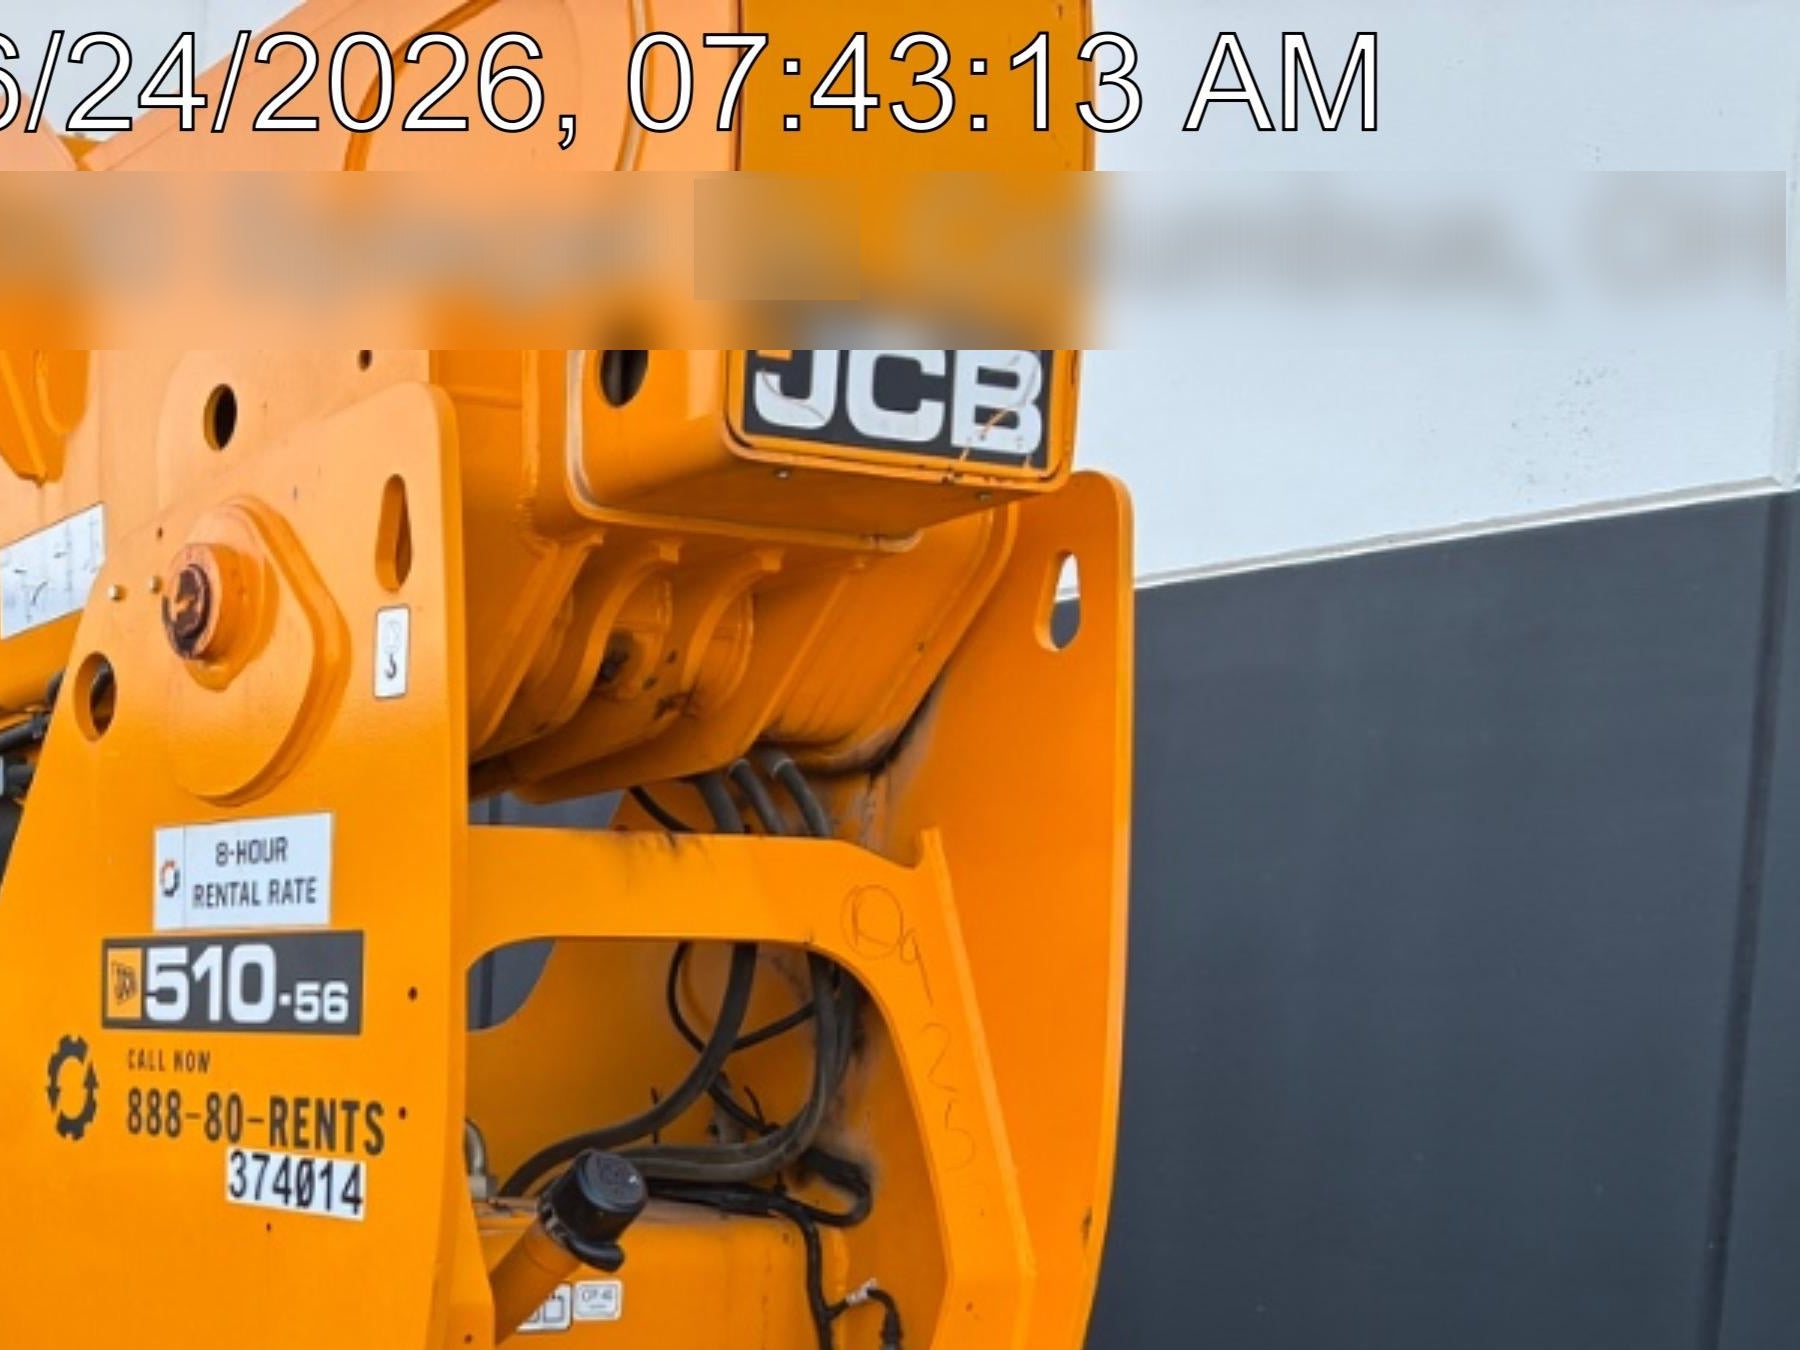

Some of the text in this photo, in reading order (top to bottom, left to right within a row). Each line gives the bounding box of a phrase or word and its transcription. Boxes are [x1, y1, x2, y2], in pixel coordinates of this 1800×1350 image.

[753, 350, 1044, 455] JCB
[215, 836, 288, 867] 8-HOUR
[193, 876, 318, 909] RENTAL RATE
[127, 1048, 211, 1074] CALL NOW
[127, 1088, 386, 1155] 888-80-RENTS
[228, 1149, 363, 1216] 374014
